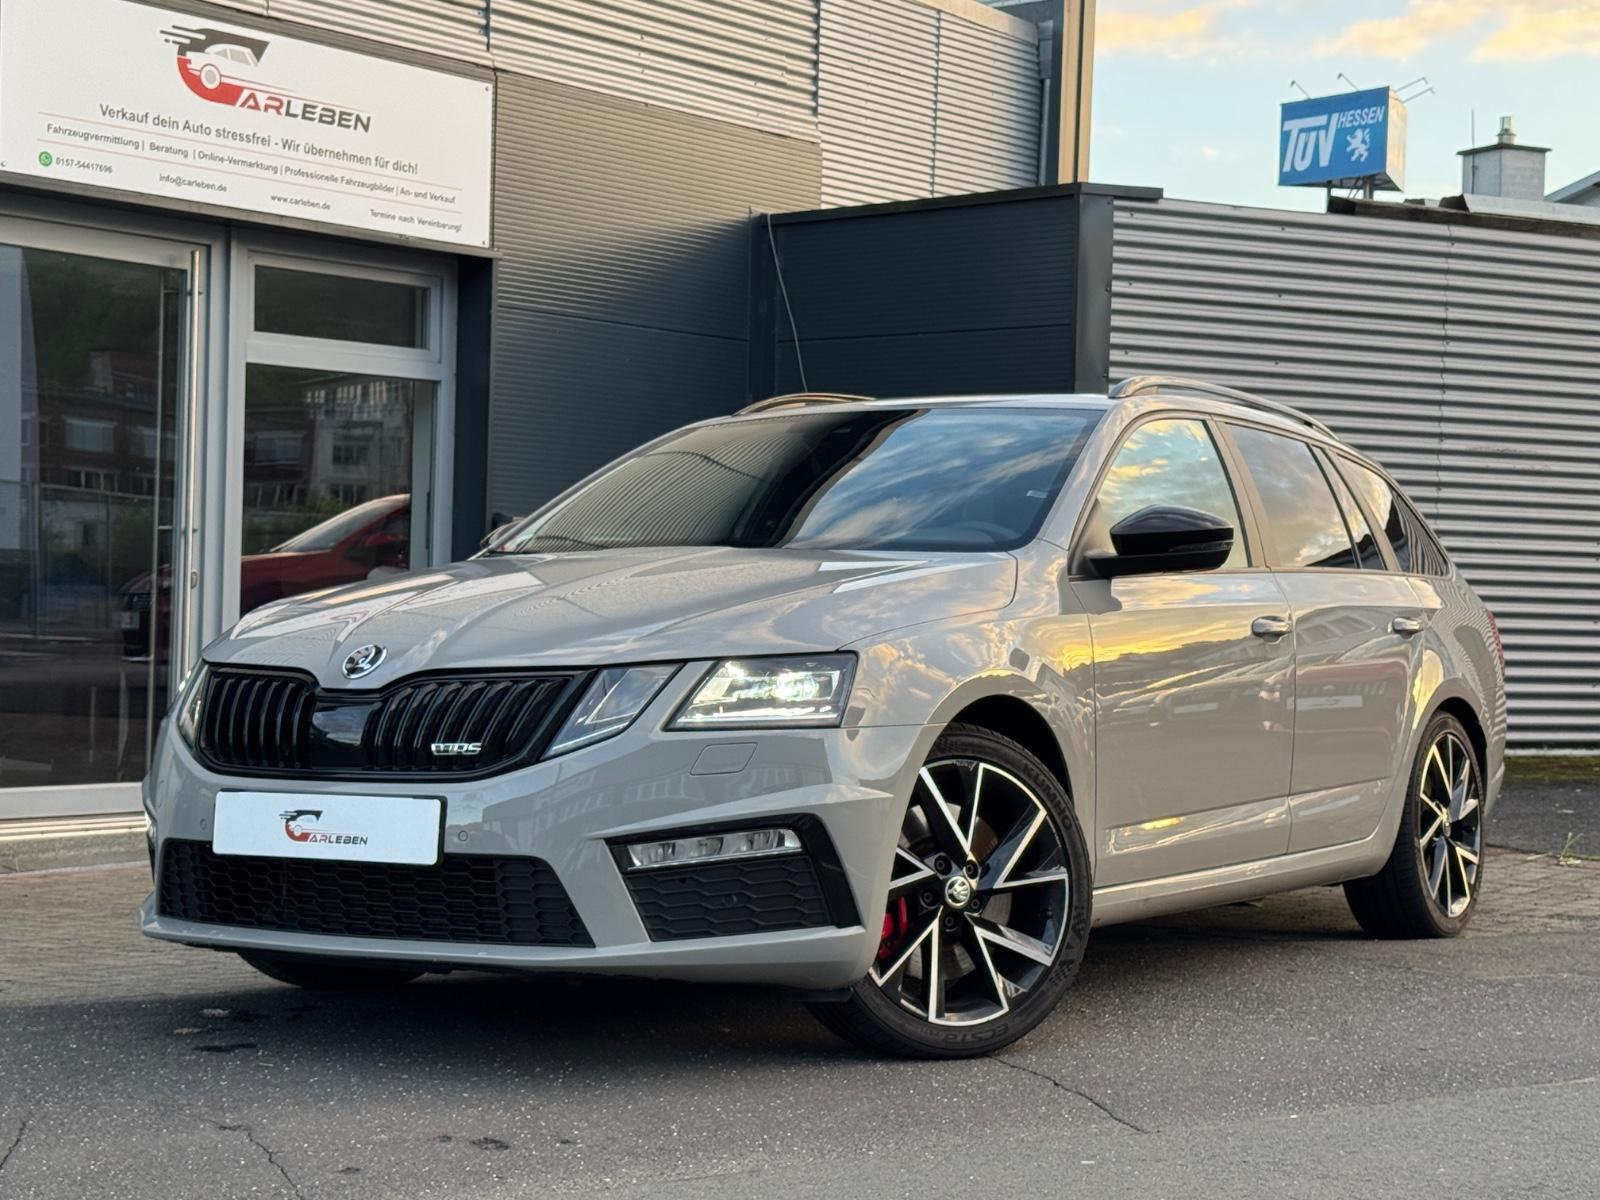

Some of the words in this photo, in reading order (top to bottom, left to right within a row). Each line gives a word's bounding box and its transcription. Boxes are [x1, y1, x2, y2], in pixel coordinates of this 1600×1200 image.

[99, 103, 149, 125] Verkauf
[152, 115, 179, 130] dein
[183, 120, 212, 137] Auto
[215, 126, 271, 148] stressfrei
[281, 138, 301, 152] Wir
[304, 142, 372, 167] übernehmen
[374, 156, 390, 170] für
[392, 159, 418, 175] dich!
[1283, 113, 1339, 172] TÜV
[1337, 106, 1385, 128] HESSEN
[46, 123, 140, 150] Fahrzeugvermittlung
[149, 142, 189, 158] Beratung
[198, 151, 279, 175] Online-Vermarktung
[284, 166, 339, 184] Professionelle
[340, 176, 395, 195] Fahrzeugbilder
[400, 187, 413, 197] An-
[414, 190, 428, 200] und
[429, 191, 456, 204] Verkauf
[159, 174, 227, 192] info@carleben.de
[270, 194, 331, 211] www.carleben.de
[370, 208, 396, 222] Termine
[398, 213, 415, 225] nach
